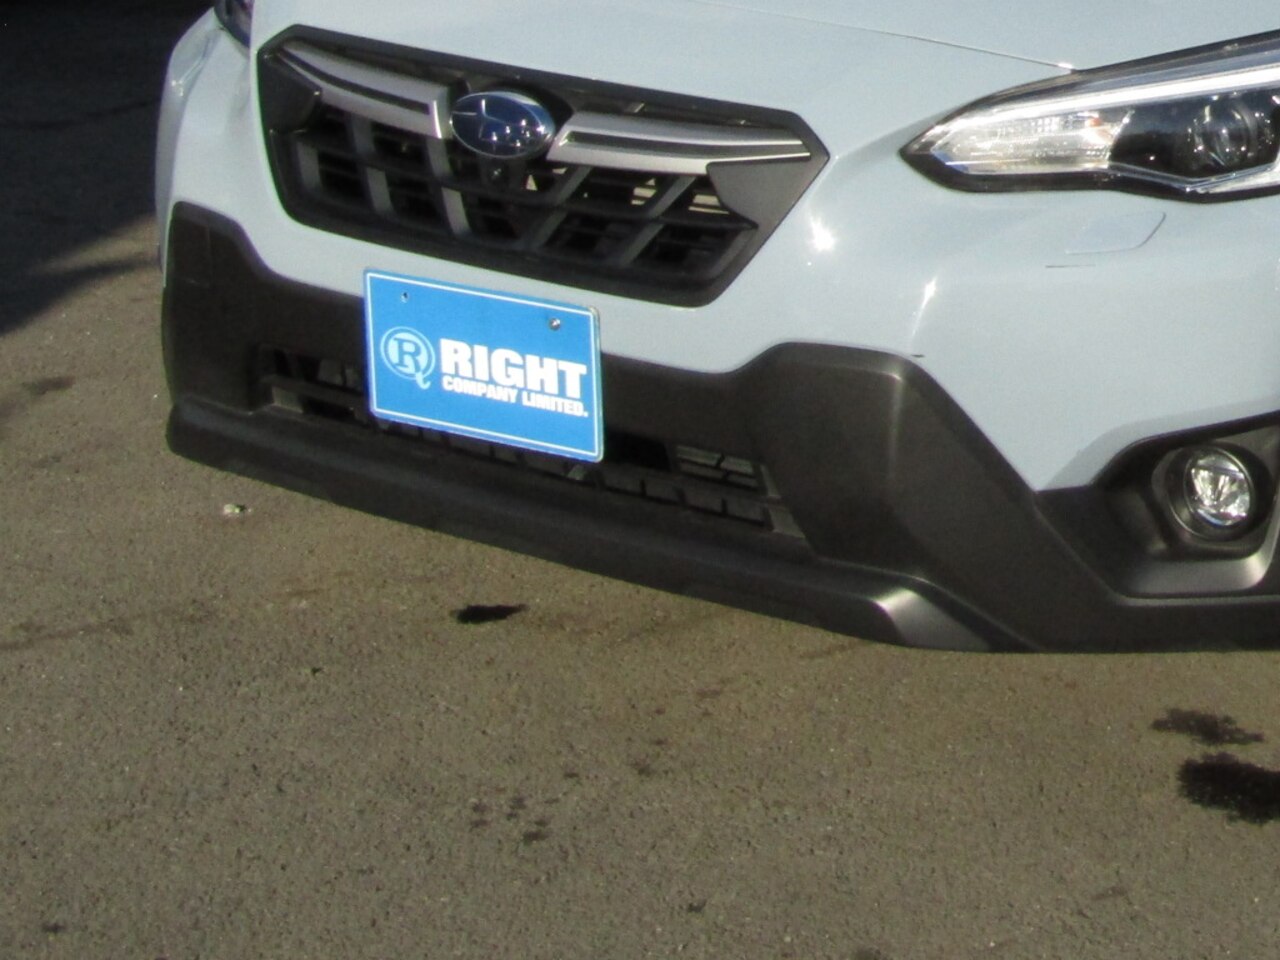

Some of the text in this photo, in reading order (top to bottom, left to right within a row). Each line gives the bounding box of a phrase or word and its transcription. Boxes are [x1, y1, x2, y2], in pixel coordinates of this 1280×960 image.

[440, 338, 587, 399] RIGHT
[442, 376, 589, 417] COMPANY LIMITED.
